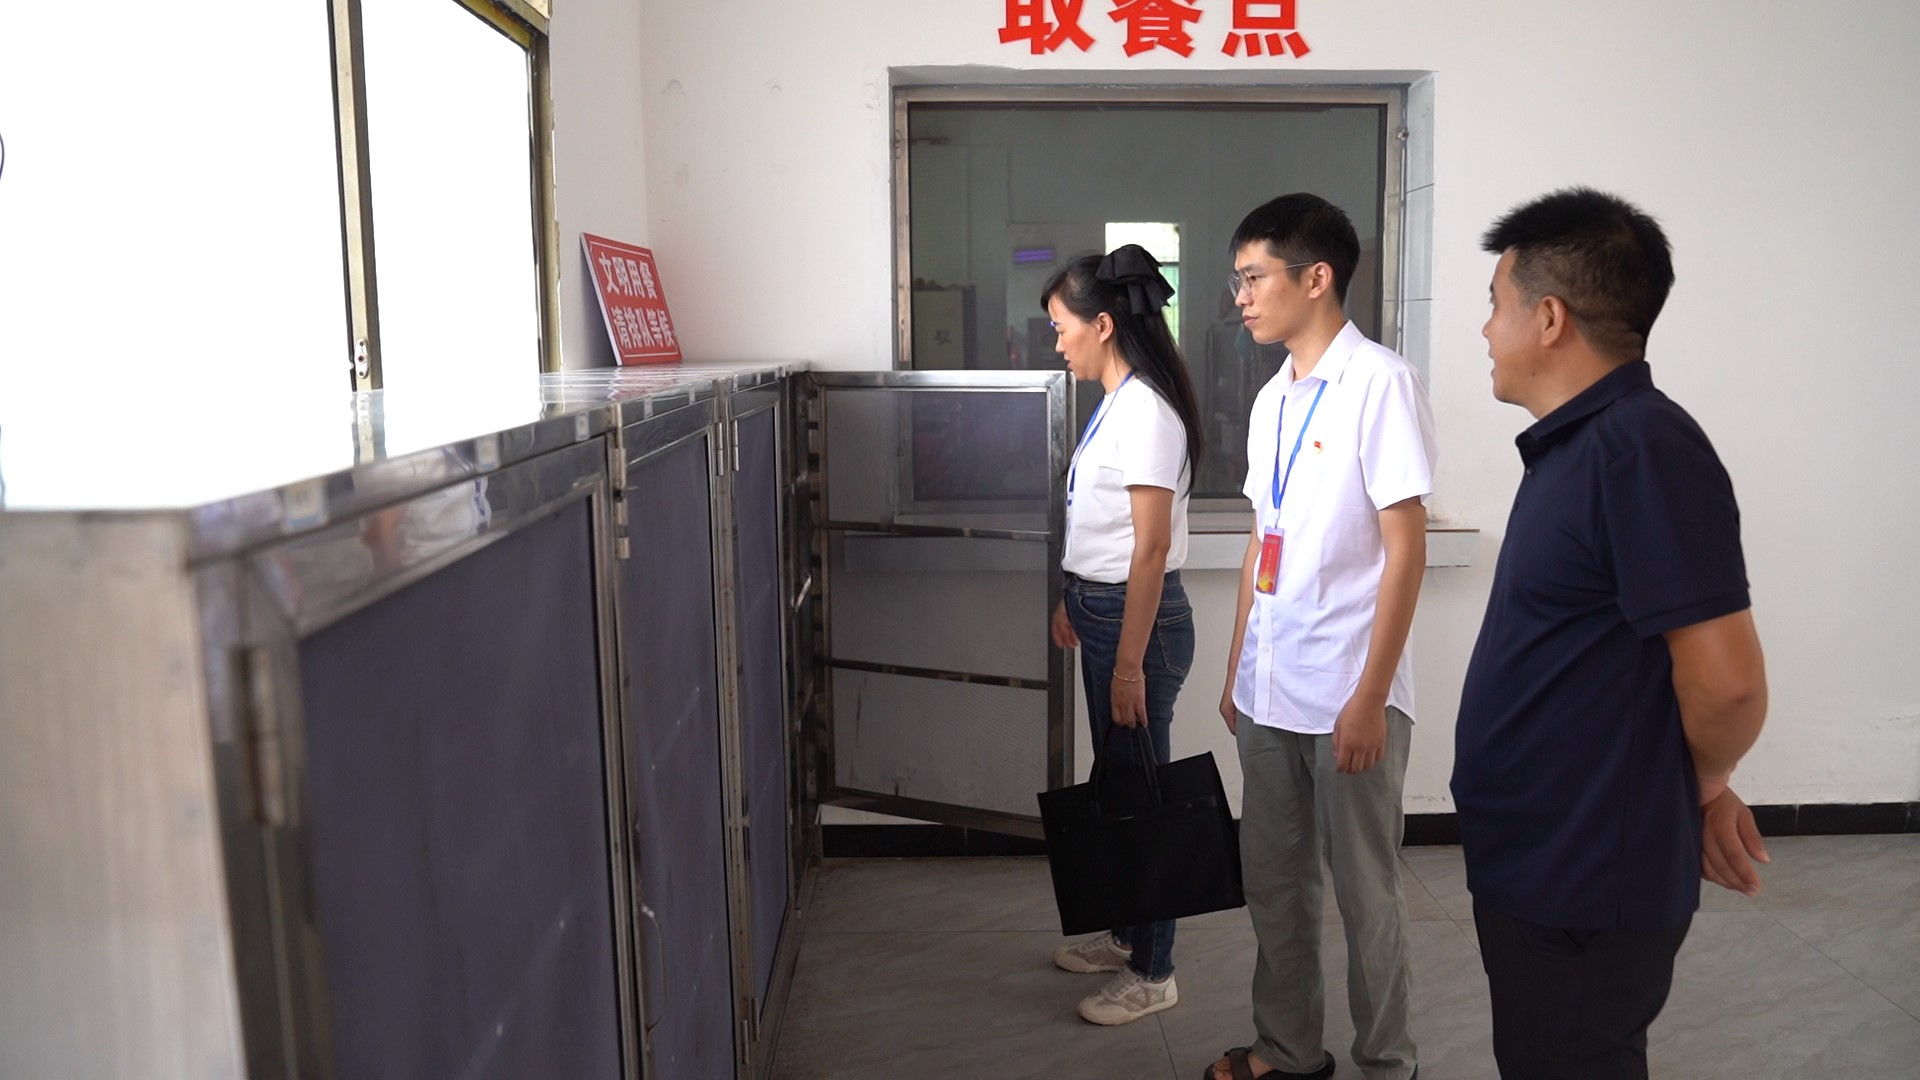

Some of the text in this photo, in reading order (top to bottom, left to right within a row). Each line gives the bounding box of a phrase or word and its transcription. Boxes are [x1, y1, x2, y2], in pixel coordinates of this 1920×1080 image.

[598, 251, 657, 299] 文明用餐
[611, 306, 675, 349] 请排队等候
